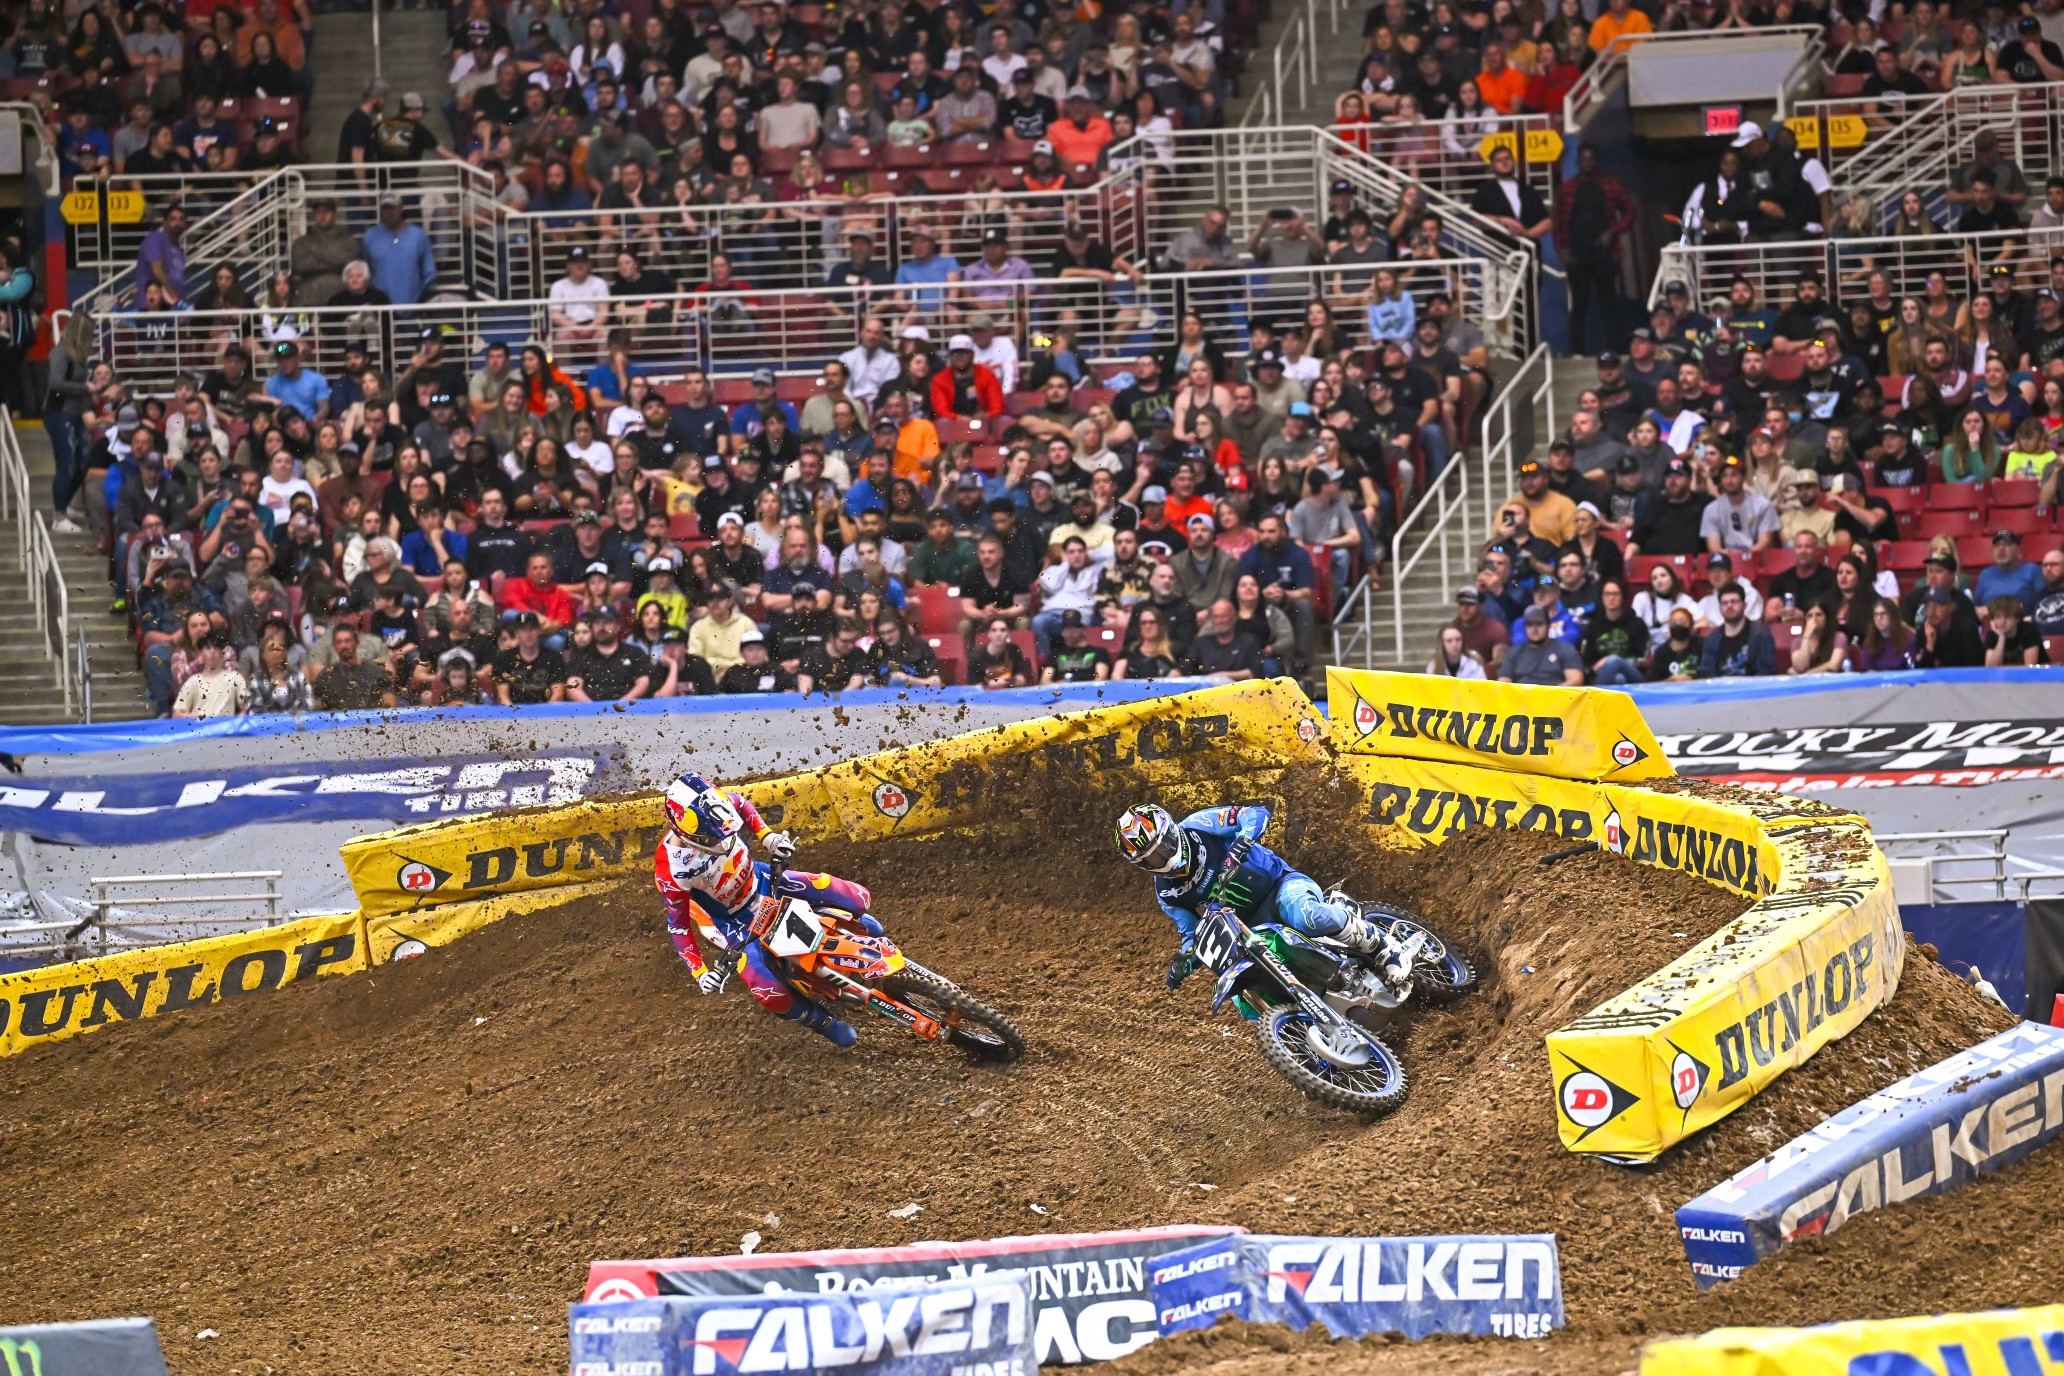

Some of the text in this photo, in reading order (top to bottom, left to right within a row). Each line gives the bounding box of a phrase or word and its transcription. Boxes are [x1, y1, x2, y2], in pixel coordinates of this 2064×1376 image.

[1793, 121, 1814, 135] 134
[1830, 120, 1851, 133] 135
[1527, 136, 1548, 149] 134
[74, 197, 94, 211] 132
[110, 196, 130, 209] 133
[1386, 702, 1564, 756] DUNLOP
[1201, 869, 1214, 889] YAMAHA
[785, 910, 817, 949] 1
[0, 933, 357, 1037] UNLOP
[877, 1000, 917, 1024] DUOP
[1297, 992, 1330, 1023] DUNLOP
[1714, 932, 1876, 1092] DUNLOP
[1569, 1088, 1608, 1110] D
[1681, 1227, 1745, 1243] FALKEN
[1154, 1251, 1236, 1285] FALKEN
[1262, 1241, 1553, 1303] FALKEN
[1692, 1262, 1743, 1279] FALKE
[1161, 1291, 1242, 1325] FALKEN
[574, 1317, 662, 1334] FALKEN
[688, 1283, 1028, 1375] FALKEN
[1490, 1313, 1553, 1338] TIRES
